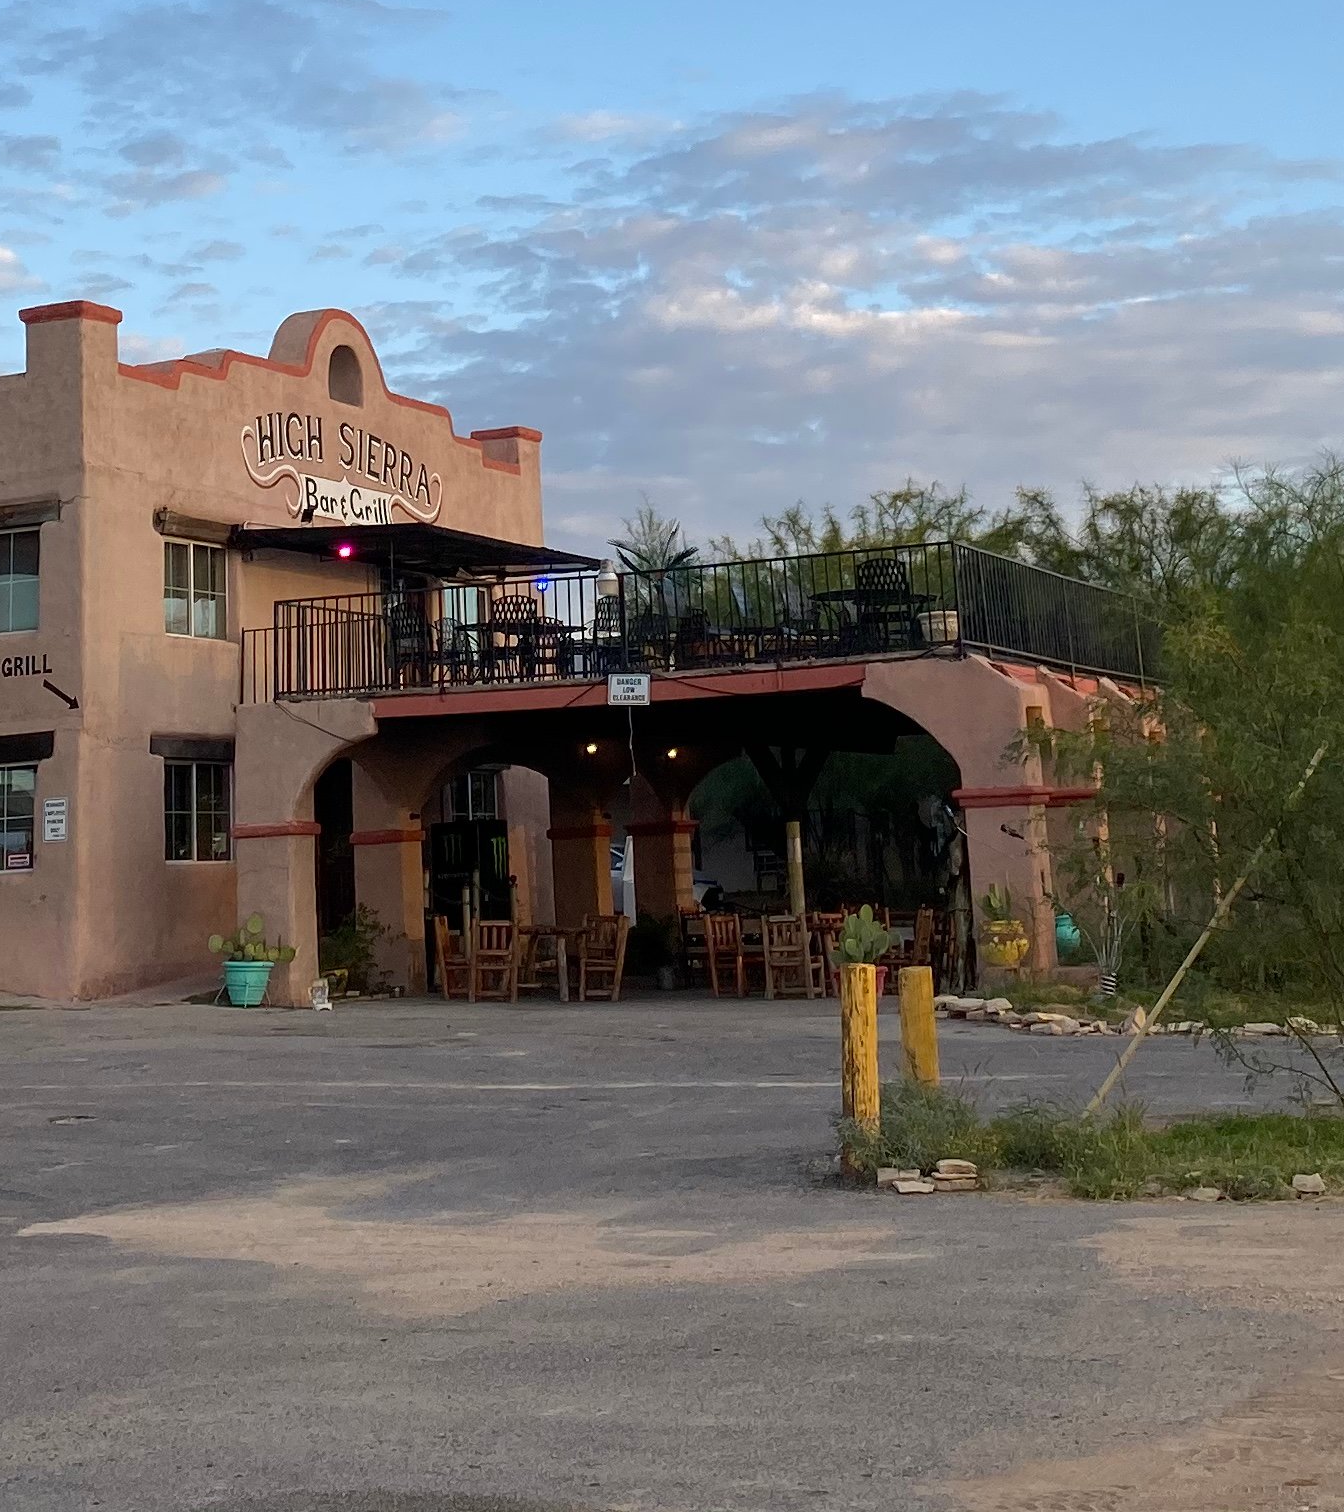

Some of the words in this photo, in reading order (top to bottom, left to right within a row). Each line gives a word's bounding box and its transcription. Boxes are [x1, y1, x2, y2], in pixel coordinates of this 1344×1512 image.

[255, 412, 324, 467] HIGH
[338, 422, 432, 508] SIERRA
[305, 476, 338, 514] Bar
[350, 488, 388, 525] Grill
[1, 653, 53, 677] GRILL
[616, 678, 642, 686] DANGER
